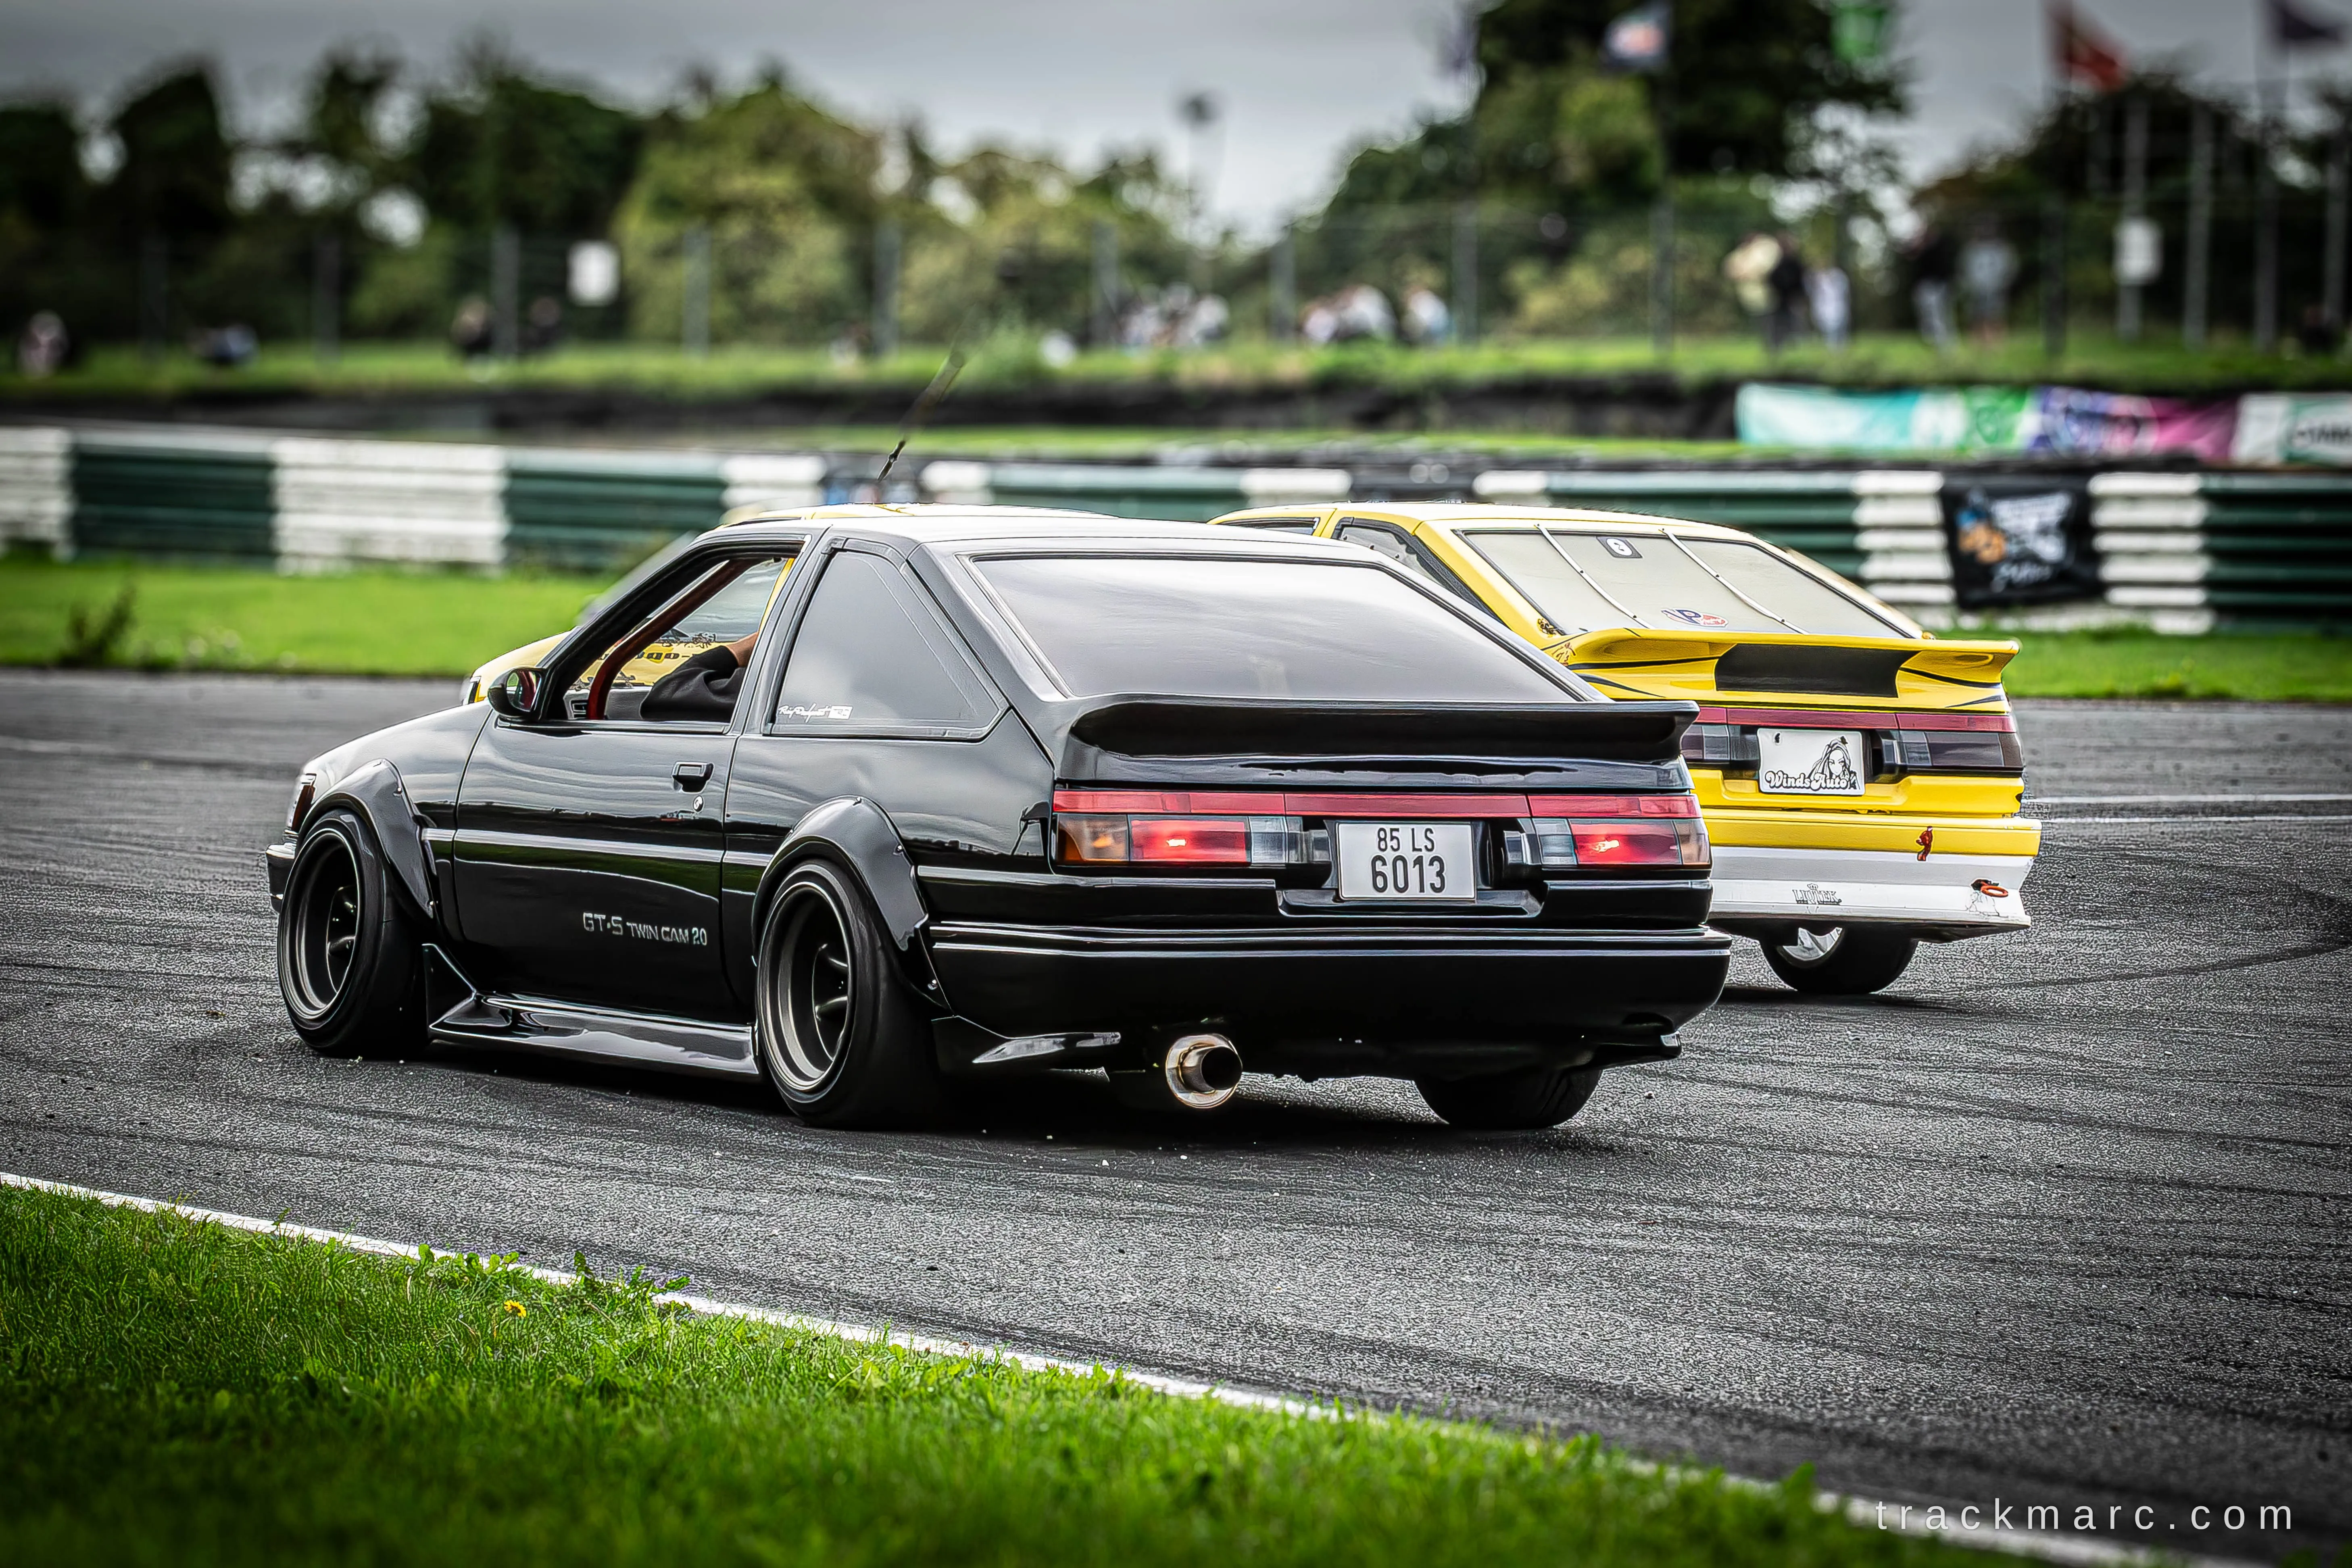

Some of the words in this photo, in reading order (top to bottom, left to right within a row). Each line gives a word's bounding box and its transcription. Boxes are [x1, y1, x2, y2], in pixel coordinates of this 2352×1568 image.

[1765, 770, 1810, 789] Winds
[1810, 772, 1848, 791] Auto
[1377, 828, 1400, 852] 85
[1411, 828, 1435, 852] LS
[1371, 855, 1445, 893] 6013
[626, 922, 659, 940] TWIN
[661, 926, 689, 944] CAM
